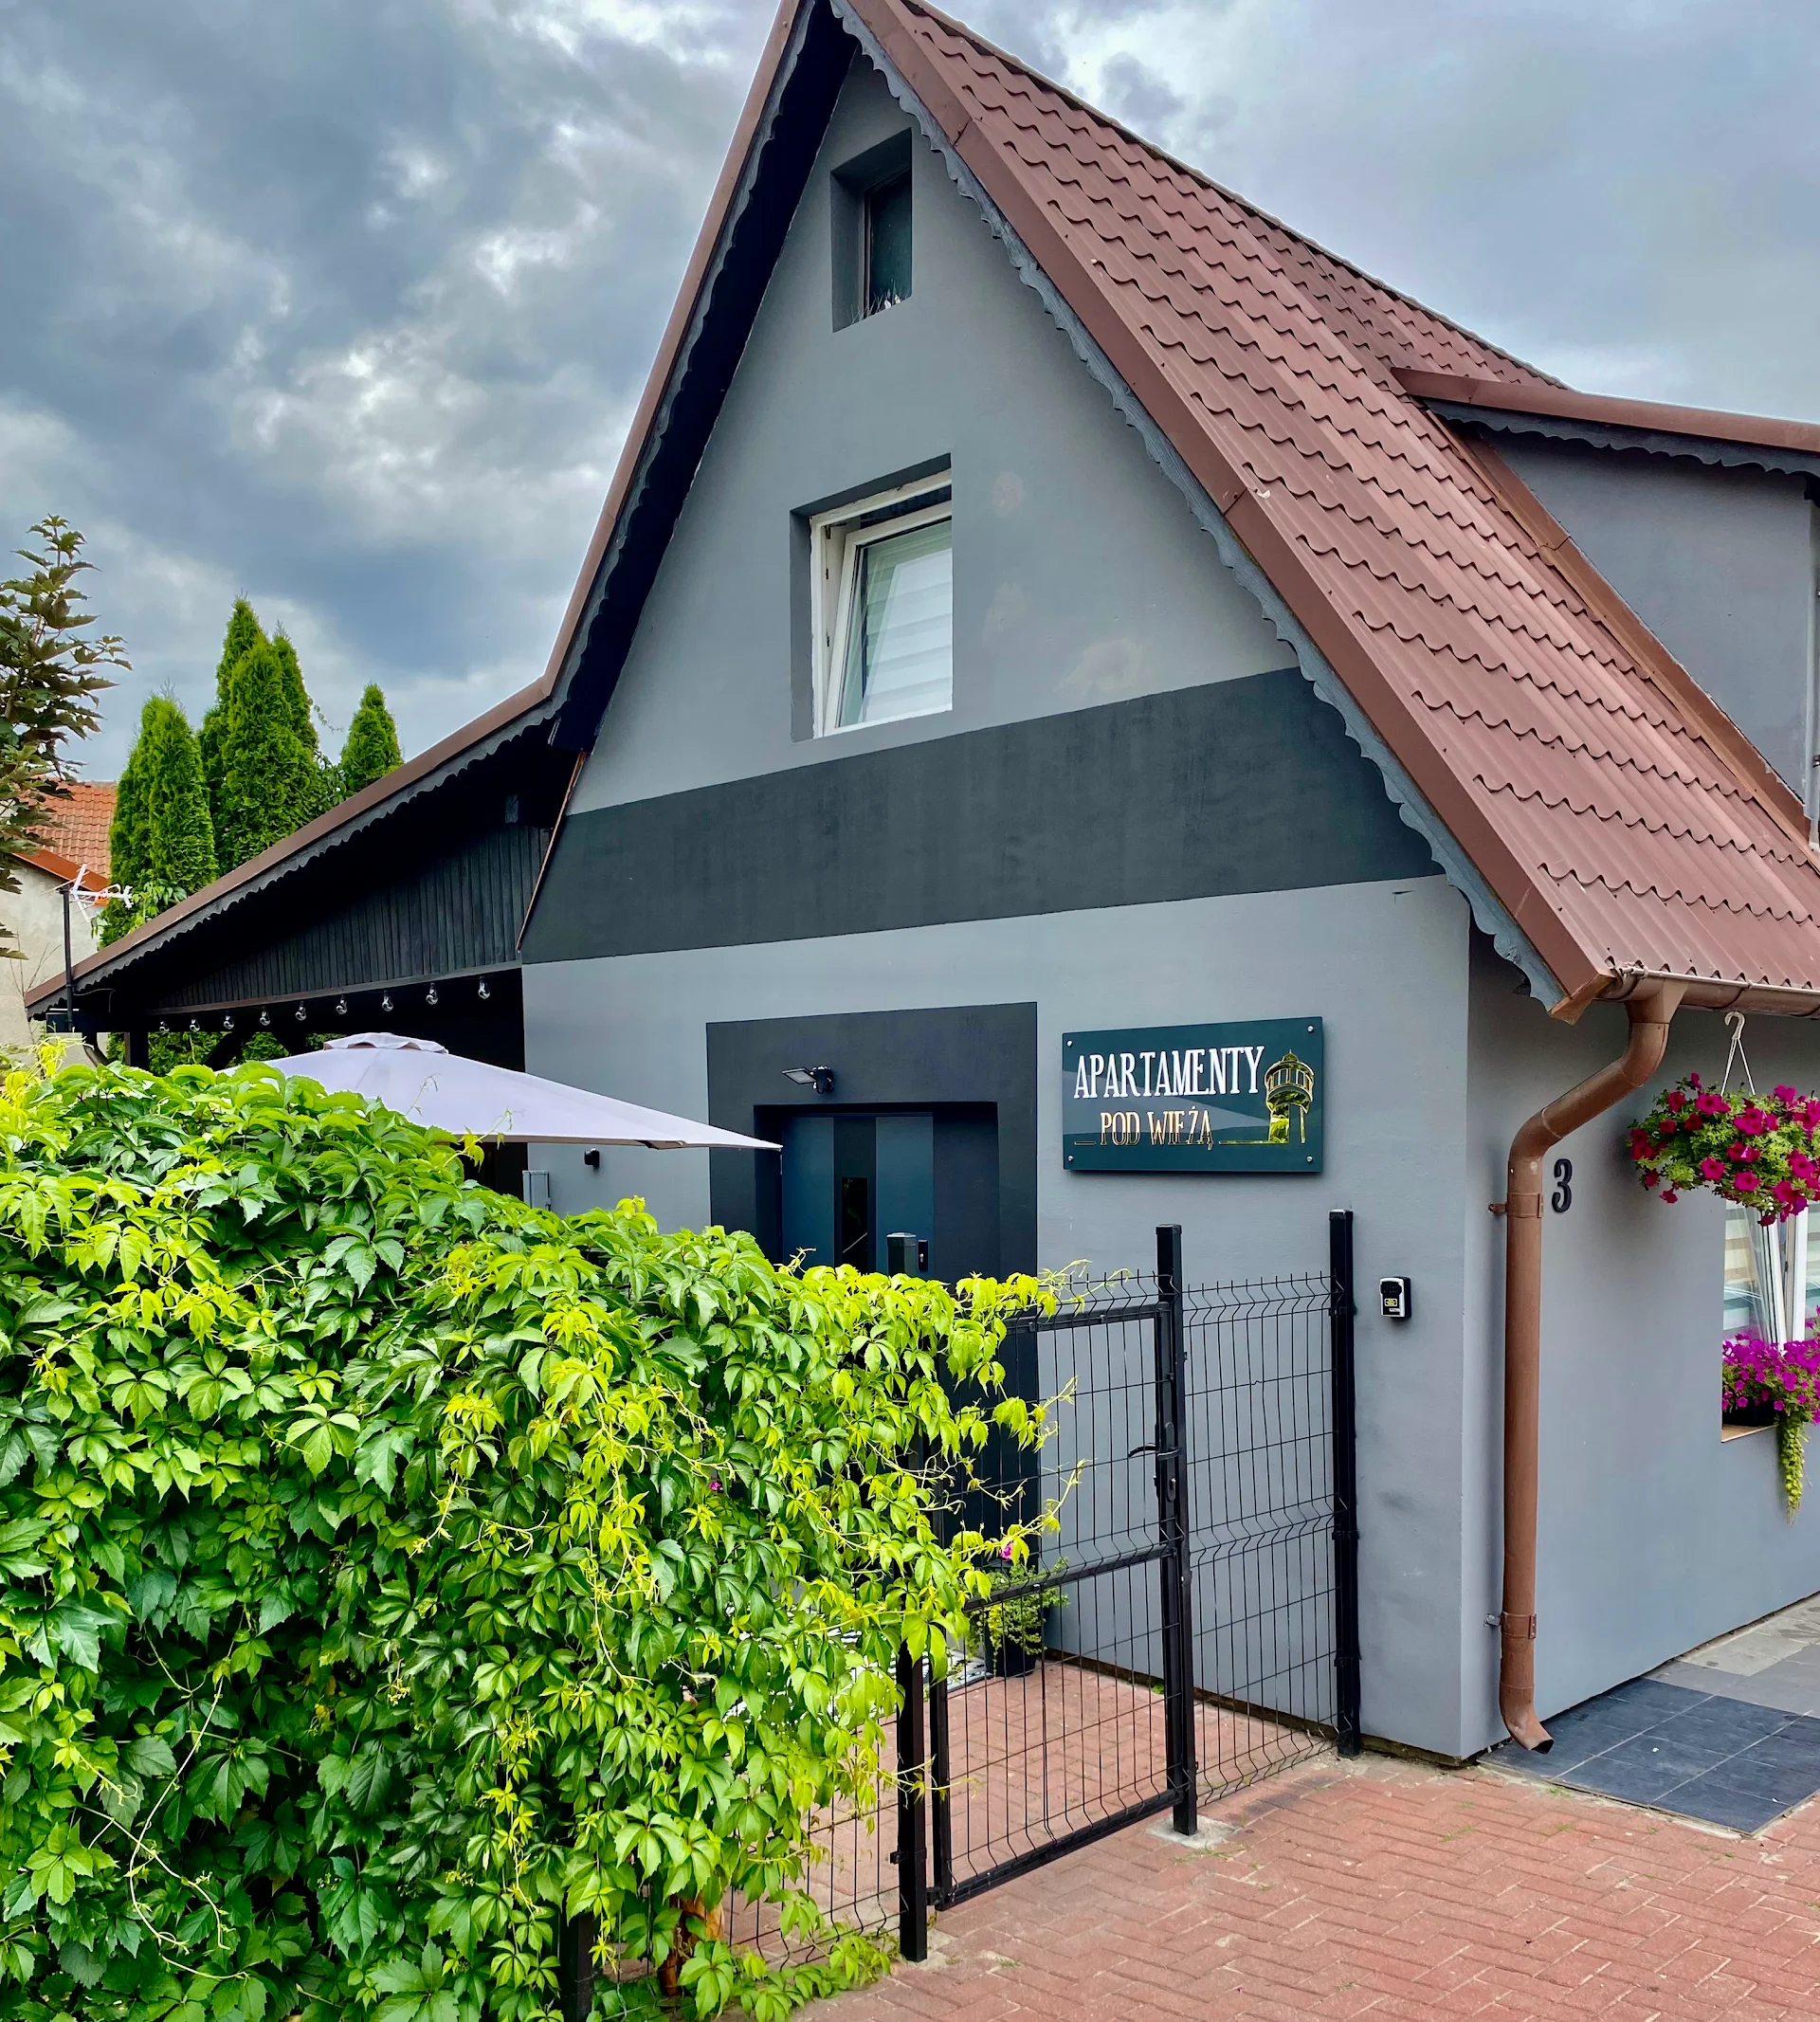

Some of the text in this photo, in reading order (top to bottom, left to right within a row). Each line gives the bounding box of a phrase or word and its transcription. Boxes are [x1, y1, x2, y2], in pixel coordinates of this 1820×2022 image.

[1074, 1046, 1265, 1099] APARTAMENTY
[1100, 1105, 1214, 1151] POD WIEŻĄ
[1551, 1158, 1573, 1213] 3
